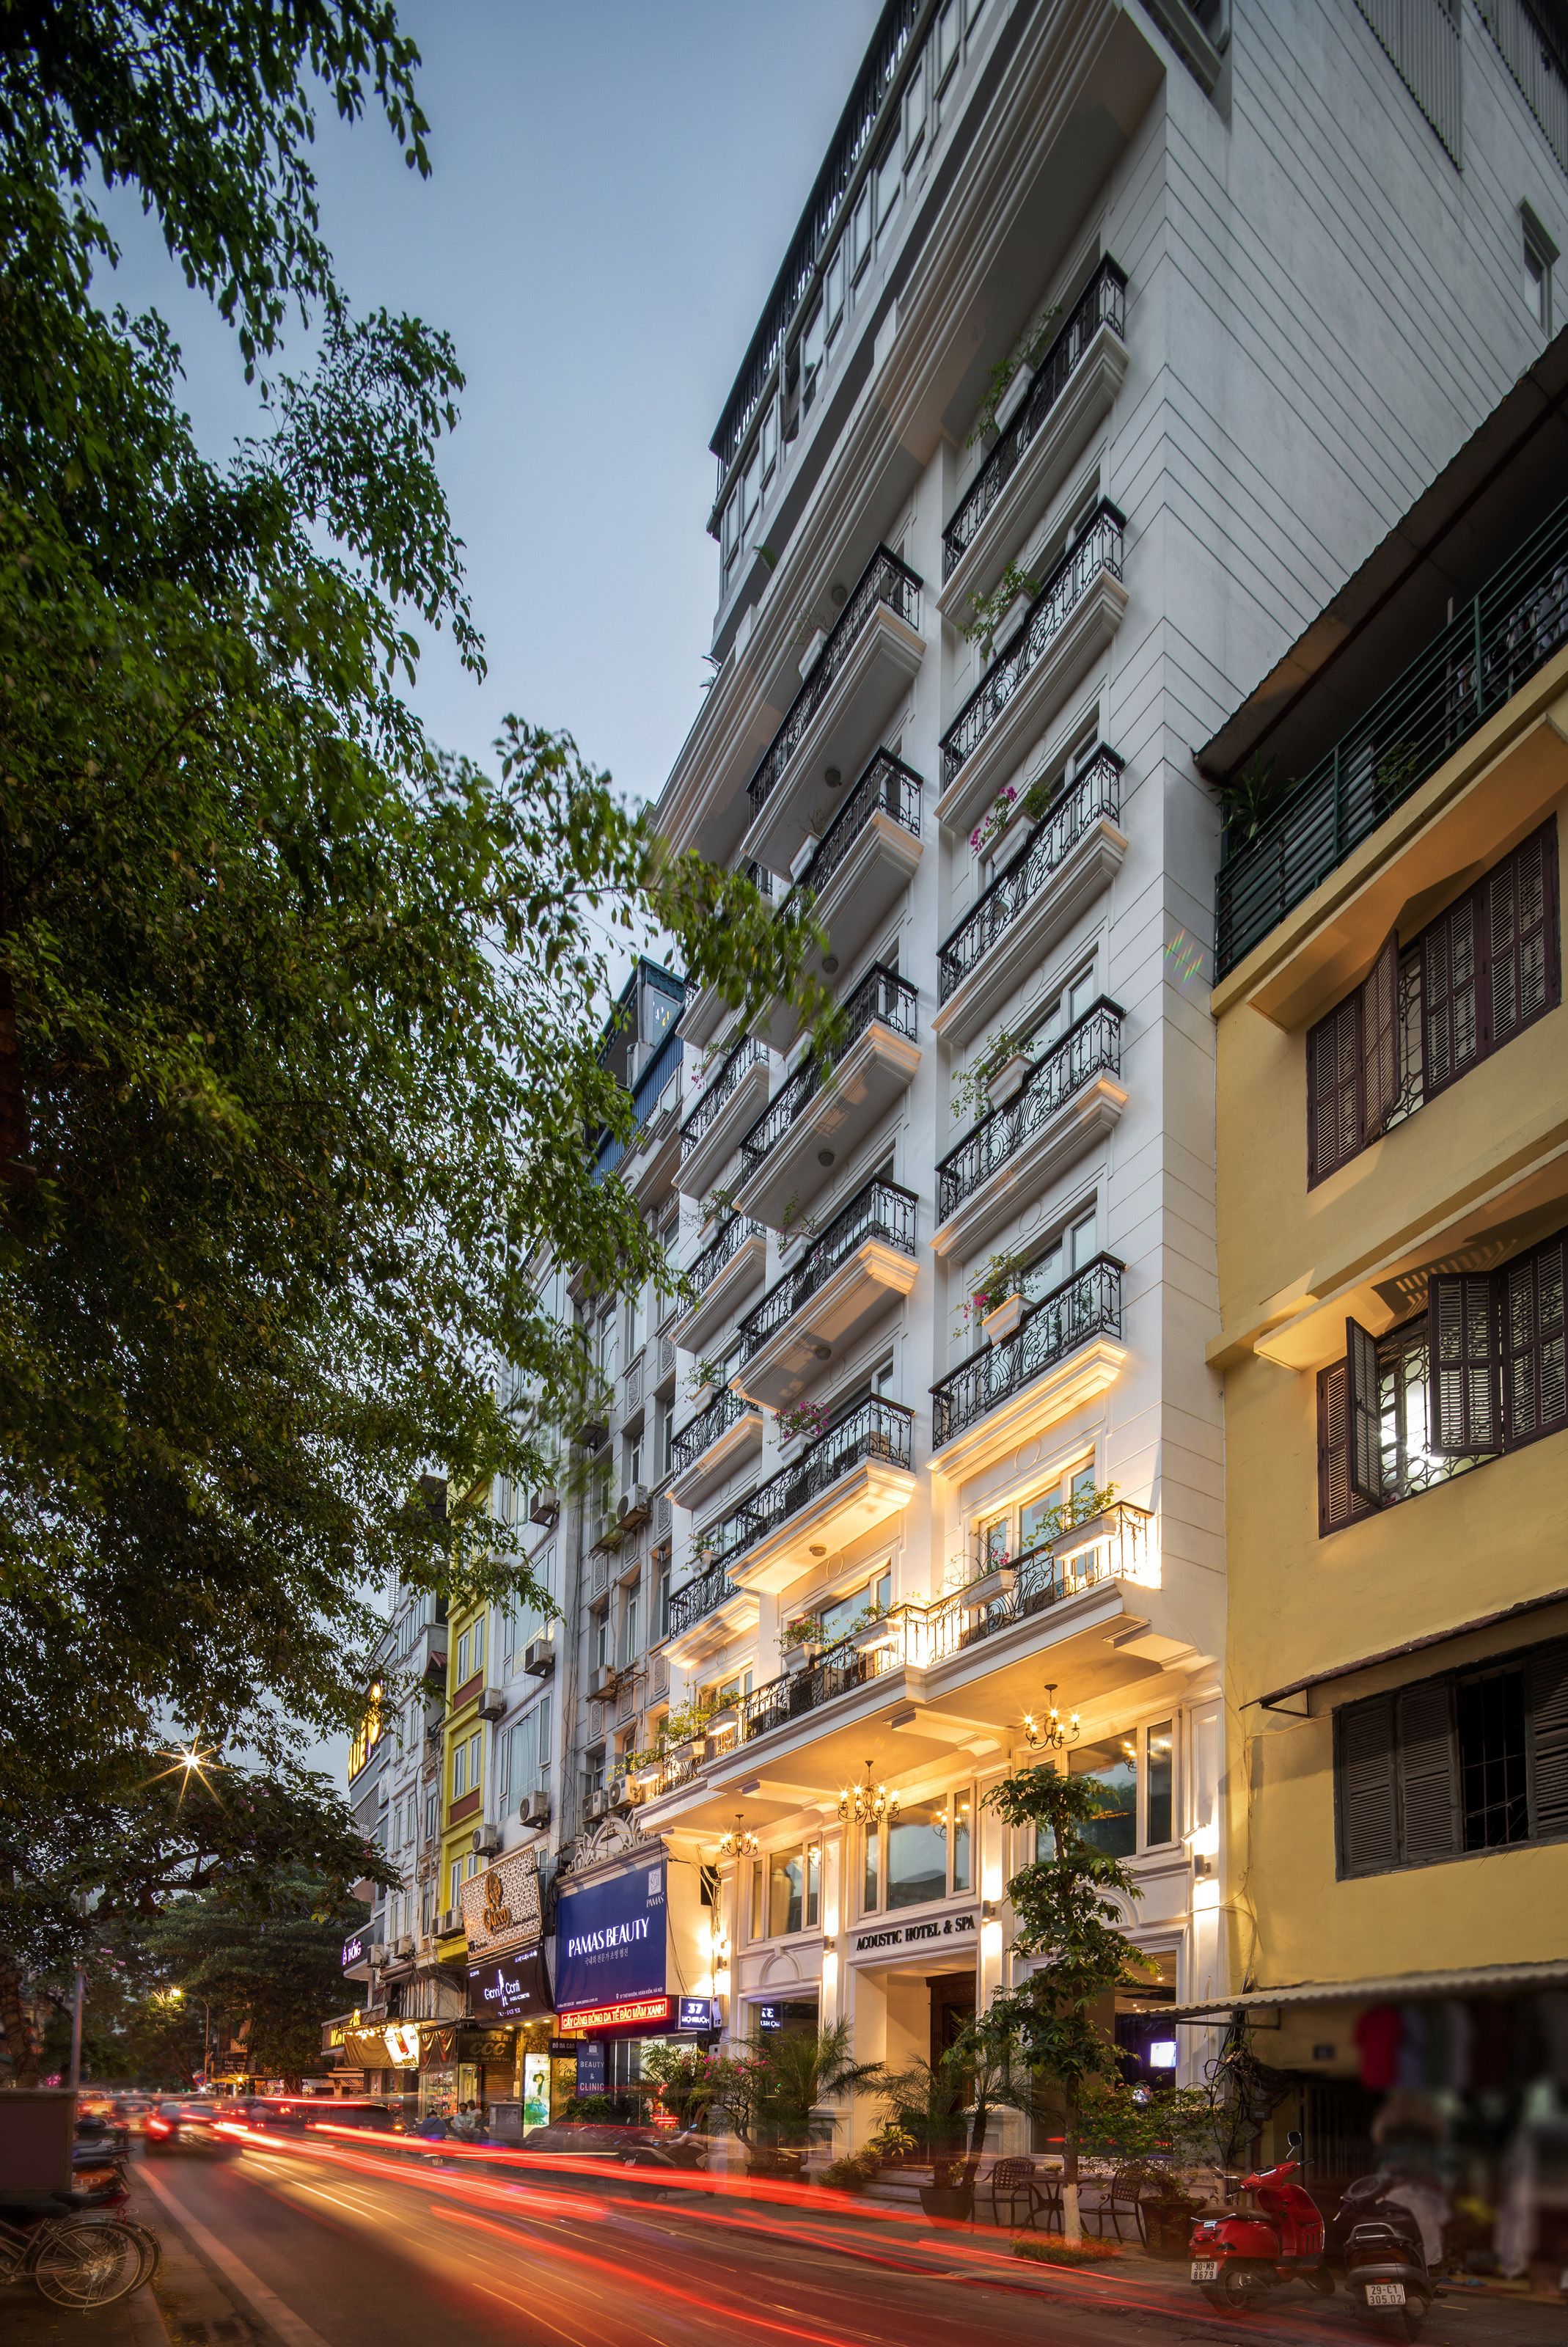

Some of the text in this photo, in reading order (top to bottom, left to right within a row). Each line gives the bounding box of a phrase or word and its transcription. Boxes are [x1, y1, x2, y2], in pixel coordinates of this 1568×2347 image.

[646, 1895, 664, 1908] PAMAS
[483, 1907, 510, 1935] Queen
[568, 1930, 604, 1958] PAMAS
[607, 1917, 650, 1948] BEAUTY
[857, 1915, 976, 1951] ACOUSTIC HOTEL & SPA
[484, 1985, 500, 2000] Gianni
[505, 1980, 521, 1995] Conti
[604, 2011, 612, 2021] DA
[647, 2004, 664, 2016] XANH
[688, 2002, 703, 2014] 37
[580, 2082, 604, 2091] CLINIC
[1194, 2262, 1215, 2271] 30-M9
[1193, 2271, 1214, 2280] 8679
[1371, 2285, 1398, 2295] 29-C1
[1369, 2295, 1403, 2304] 305.02
